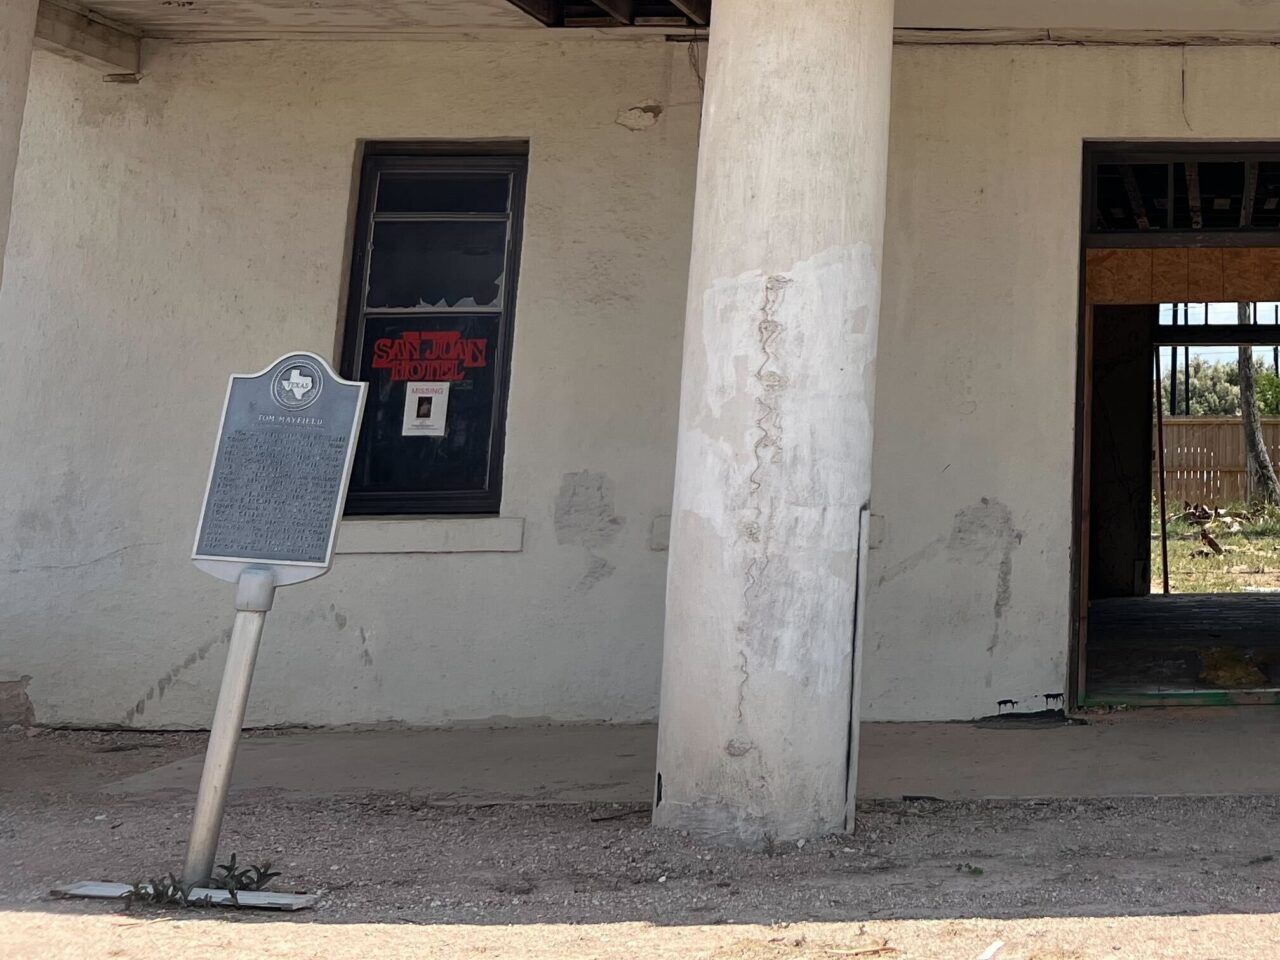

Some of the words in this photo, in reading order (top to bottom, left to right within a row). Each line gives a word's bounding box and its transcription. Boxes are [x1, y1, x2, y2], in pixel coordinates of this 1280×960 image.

[372, 337, 421, 368] SAN
[424, 337, 488, 367] JUAN
[390, 359, 466, 381] HOTEL
[286, 381, 310, 389] TEXAS
[258, 414, 275, 422] TOM
[278, 416, 323, 425] MAYFIELD
